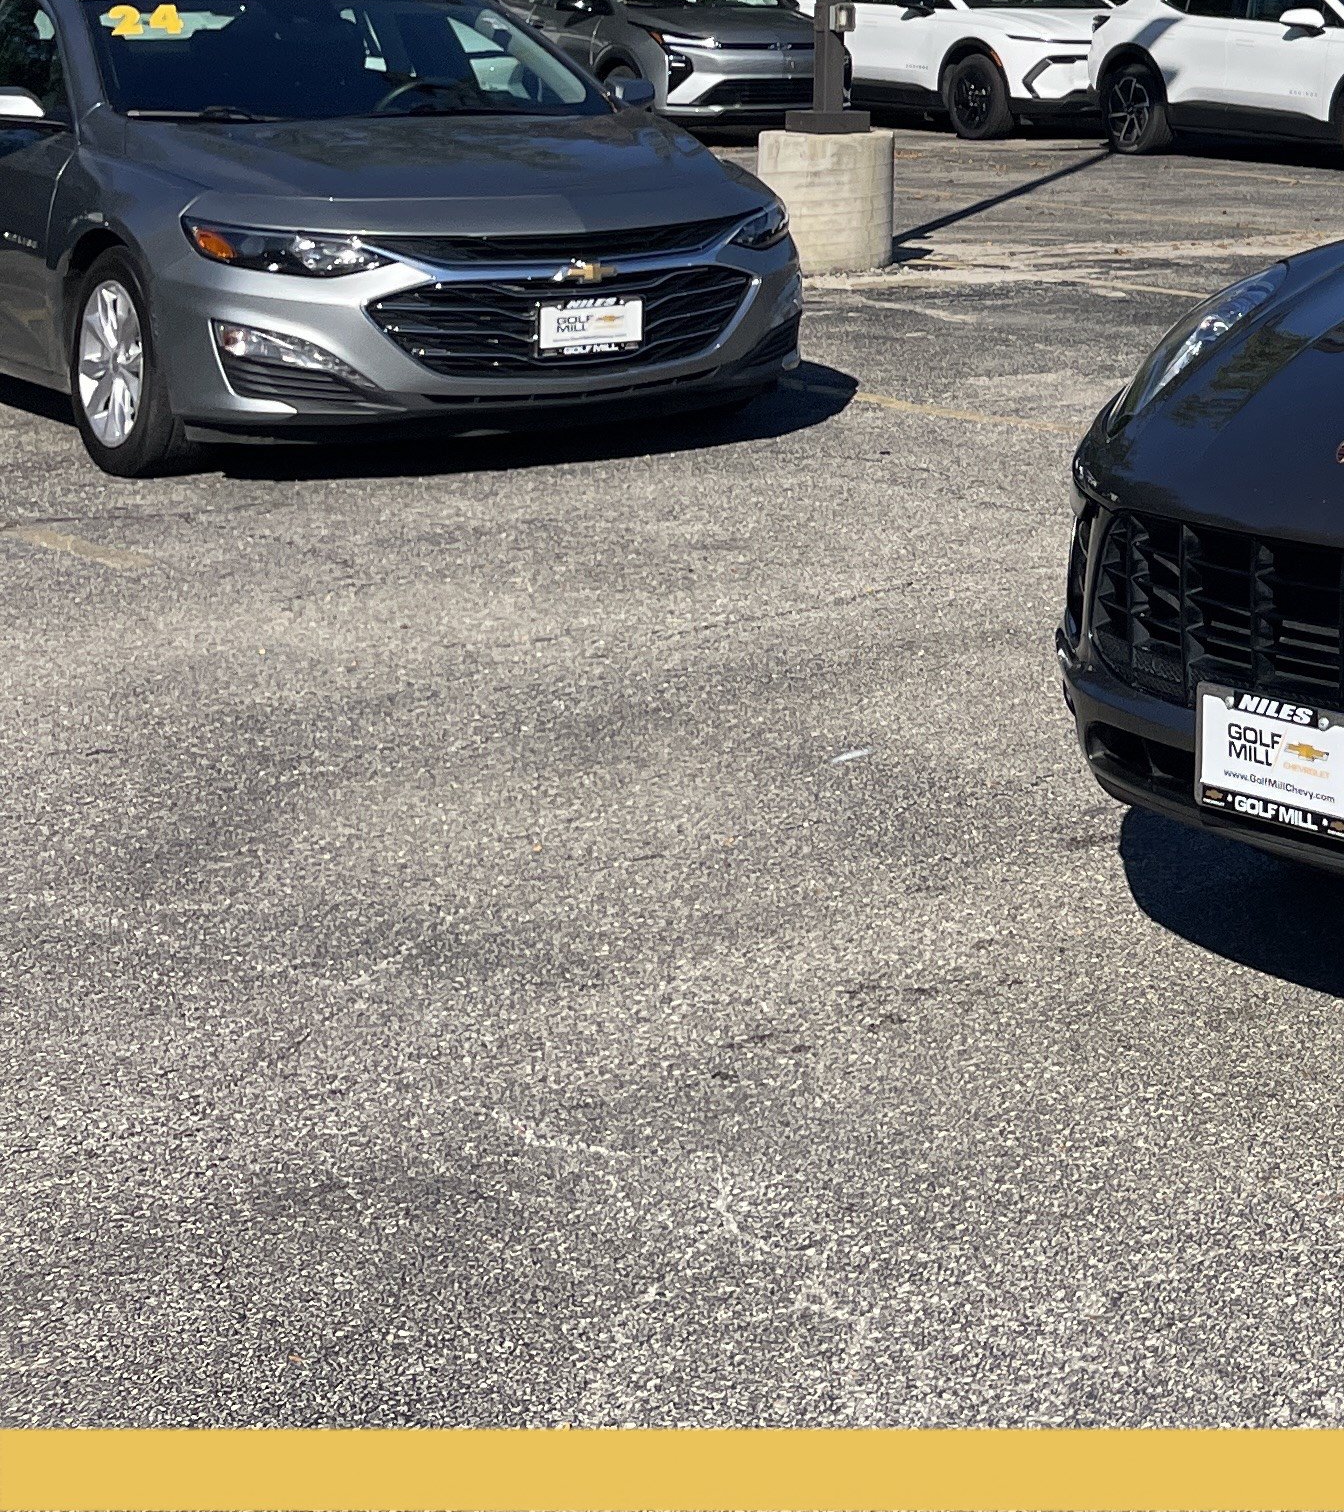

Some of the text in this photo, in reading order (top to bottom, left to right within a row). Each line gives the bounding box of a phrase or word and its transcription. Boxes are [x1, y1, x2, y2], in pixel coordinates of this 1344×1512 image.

[108, 4, 184, 36] 24
[557, 315, 593, 325] GOLF
[557, 324, 586, 333] MILL
[1238, 694, 1313, 725] NILES
[1227, 723, 1283, 750] GOLF
[1228, 741, 1273, 767] MILL
[1224, 769, 1336, 803] www.GolfMillChevy.com
[1234, 794, 1319, 830] GOLF MILL
